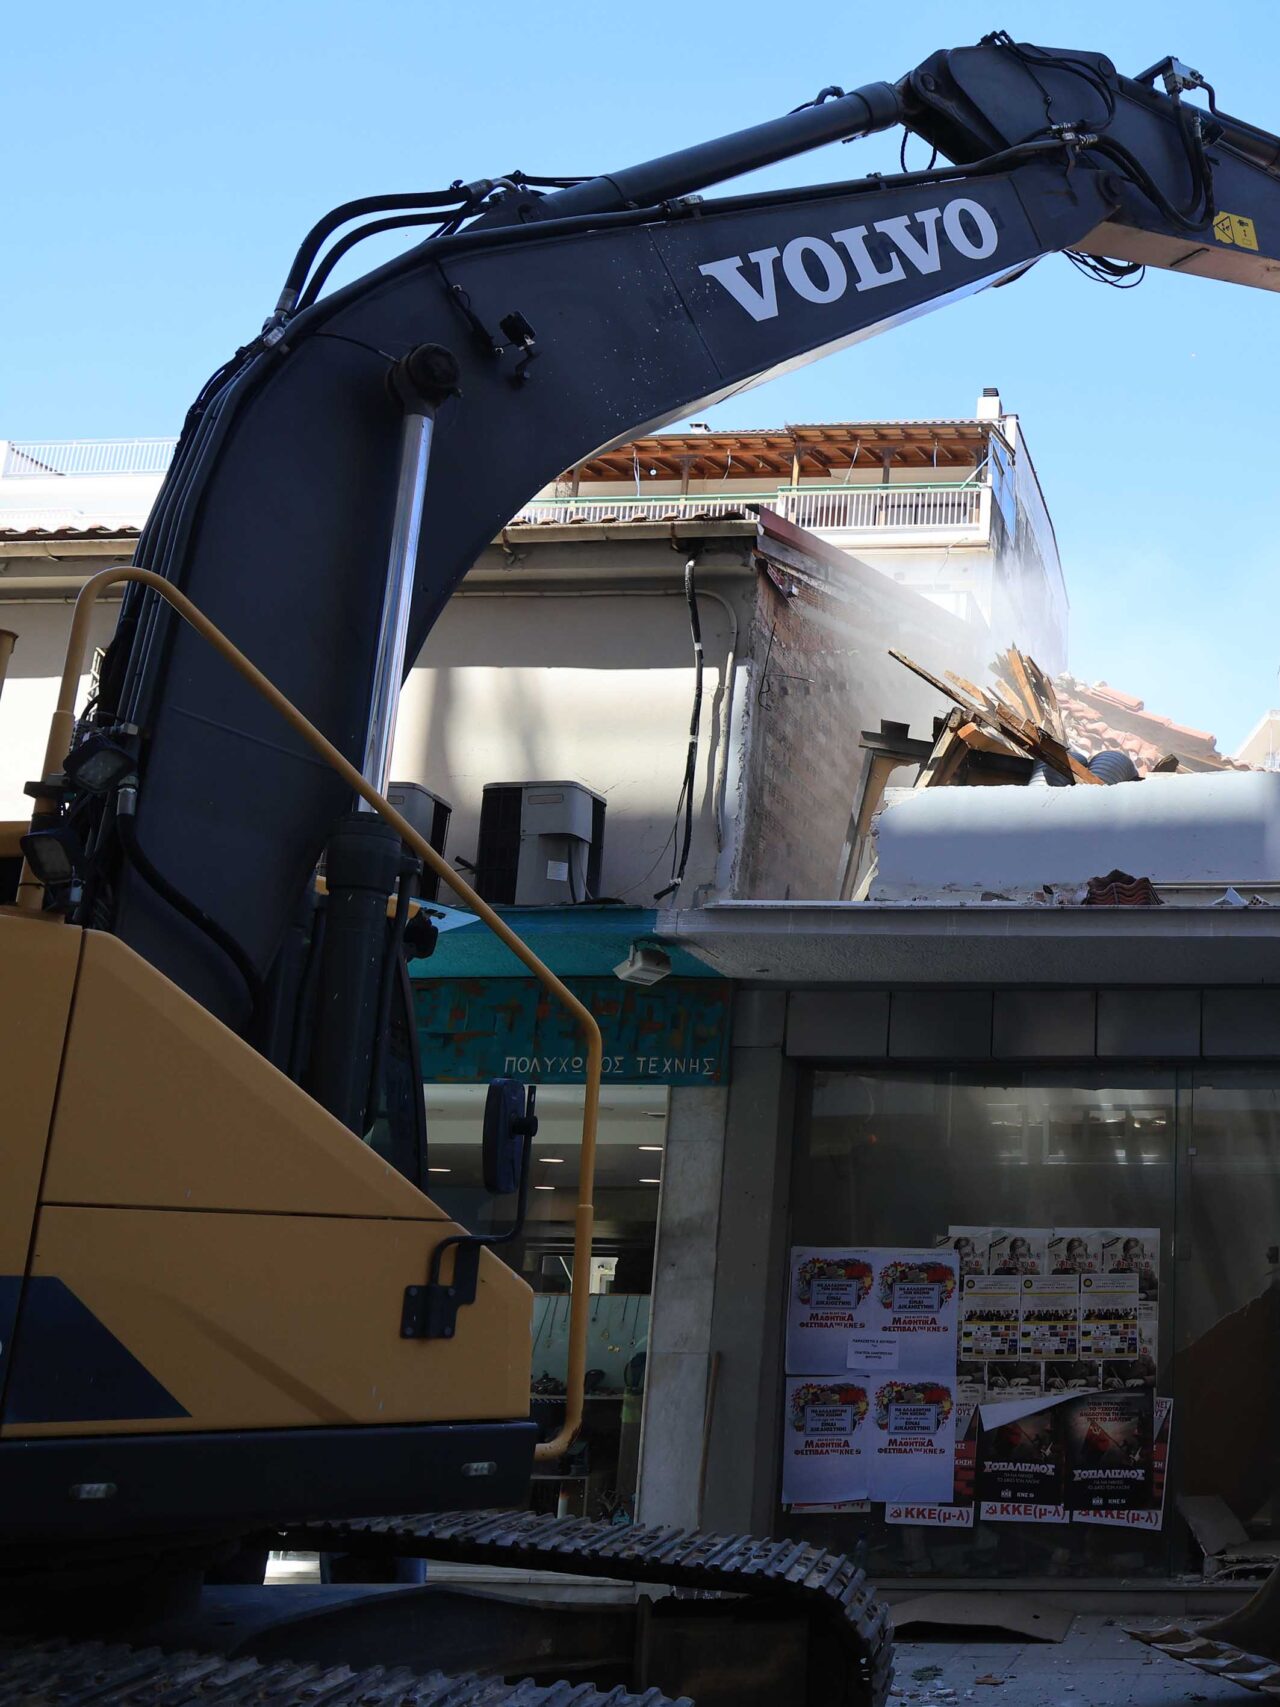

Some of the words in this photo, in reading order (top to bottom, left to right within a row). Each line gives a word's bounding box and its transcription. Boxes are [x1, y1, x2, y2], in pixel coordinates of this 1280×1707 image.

[698, 199, 998, 322] VOLVO
[504, 1056, 624, 1073] ΠΟΛΥΧΩΟΣ
[637, 1057, 716, 1075] ΤΕΧΝΗΣ
[809, 1313, 854, 1322] ΜΑΘΗΤΙΚΑ
[892, 1317, 937, 1325] ΜΑΘΗΤΙΚΑ
[805, 1440, 850, 1448] ΜΑΘΗΤΙΚΑ
[888, 1439, 934, 1447] ΜΑΘΗΤΙΚΑ
[984, 1462, 1056, 1476] ΣΟΣΙΑΛΙΣΜΟΣ
[1072, 1469, 1146, 1481] ΣΟΣΙΑΛΙΣΜΟΣ
[905, 1507, 970, 1522] ΚΚΕ(μ-λ)
[1000, 1504, 1065, 1519] ΚΚΕ(μ-λ)
[1093, 1508, 1159, 1525] ΚΚΕ(μ-λ)
